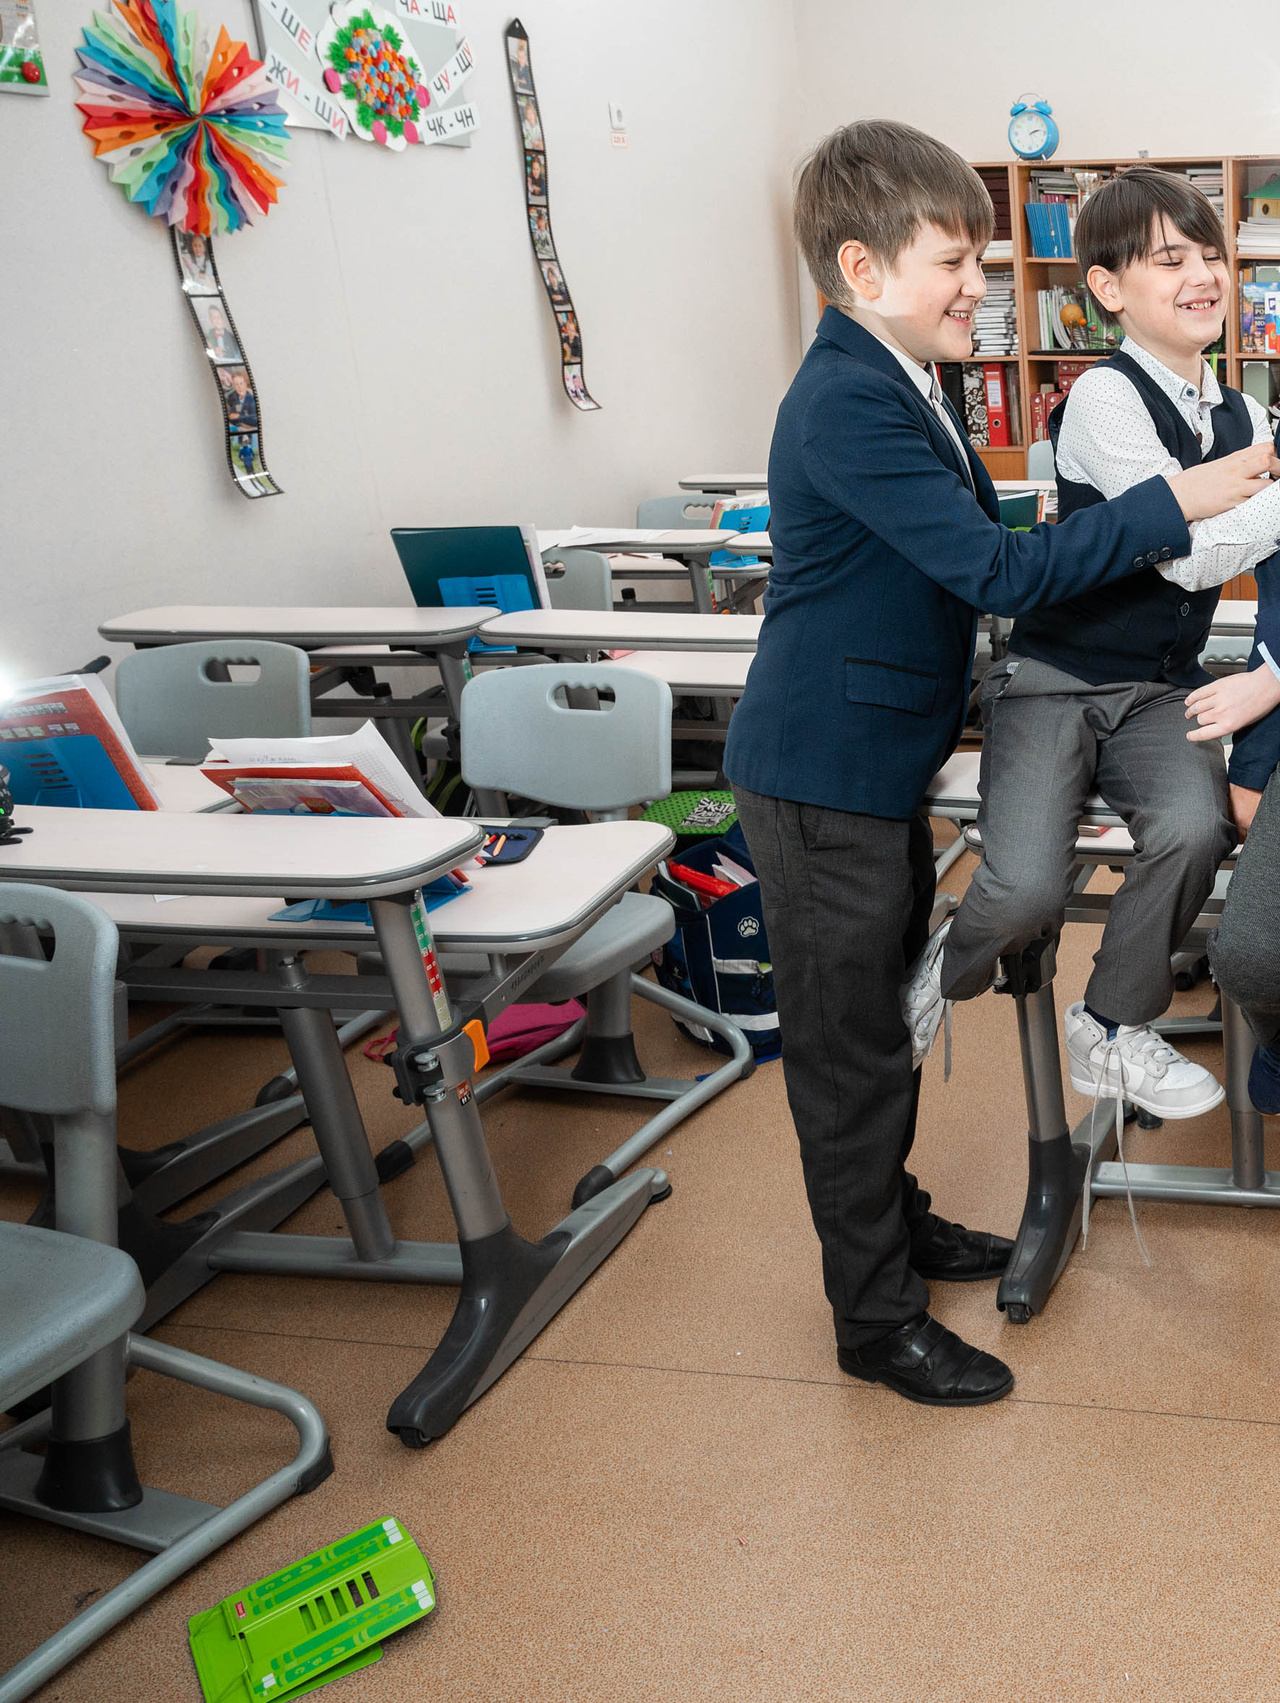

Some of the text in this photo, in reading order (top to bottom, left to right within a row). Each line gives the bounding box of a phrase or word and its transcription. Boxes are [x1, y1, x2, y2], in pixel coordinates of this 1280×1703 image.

[280, 7, 312, 52] ШЕ
[432, 2, 457, 25] ЩА
[433, 69, 452, 94] ЧУ
[456, 42, 474, 74] ЩУ
[269, 55, 300, 95] ЖИ
[314, 95, 345, 136] ШИ
[426, 119, 448, 137] ЧК
[455, 107, 475, 128] ЧН
